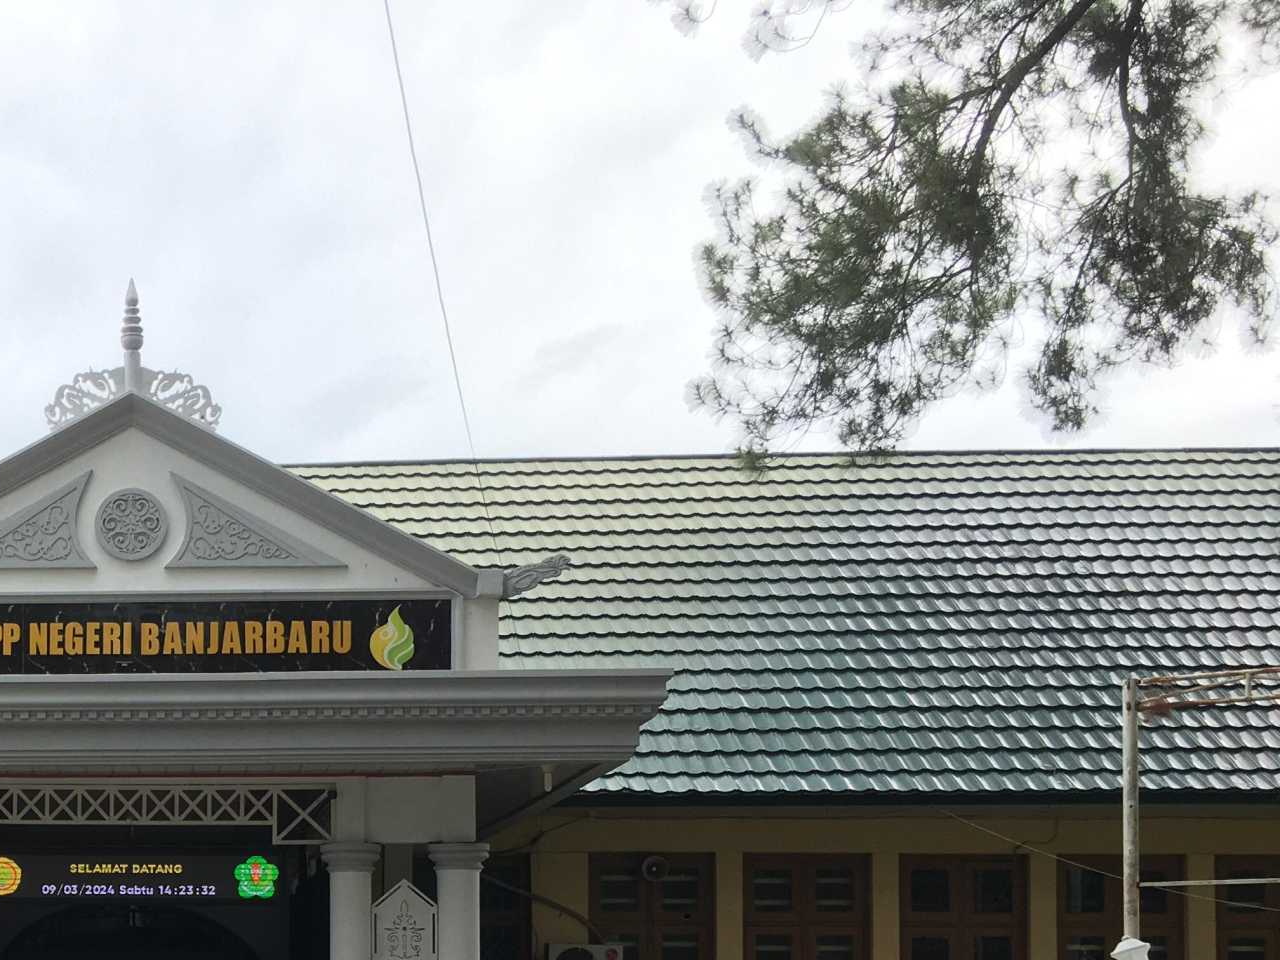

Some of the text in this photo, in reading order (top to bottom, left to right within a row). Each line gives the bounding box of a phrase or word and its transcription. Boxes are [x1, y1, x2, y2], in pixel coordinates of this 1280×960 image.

[28, 620, 132, 656] NEGERI
[140, 619, 352, 655] BANJARBARU
[70, 864, 183, 874] SELAMAT DATANG
[41, 884, 216, 896] 09/03/2024 Sabtu 14:23:32
